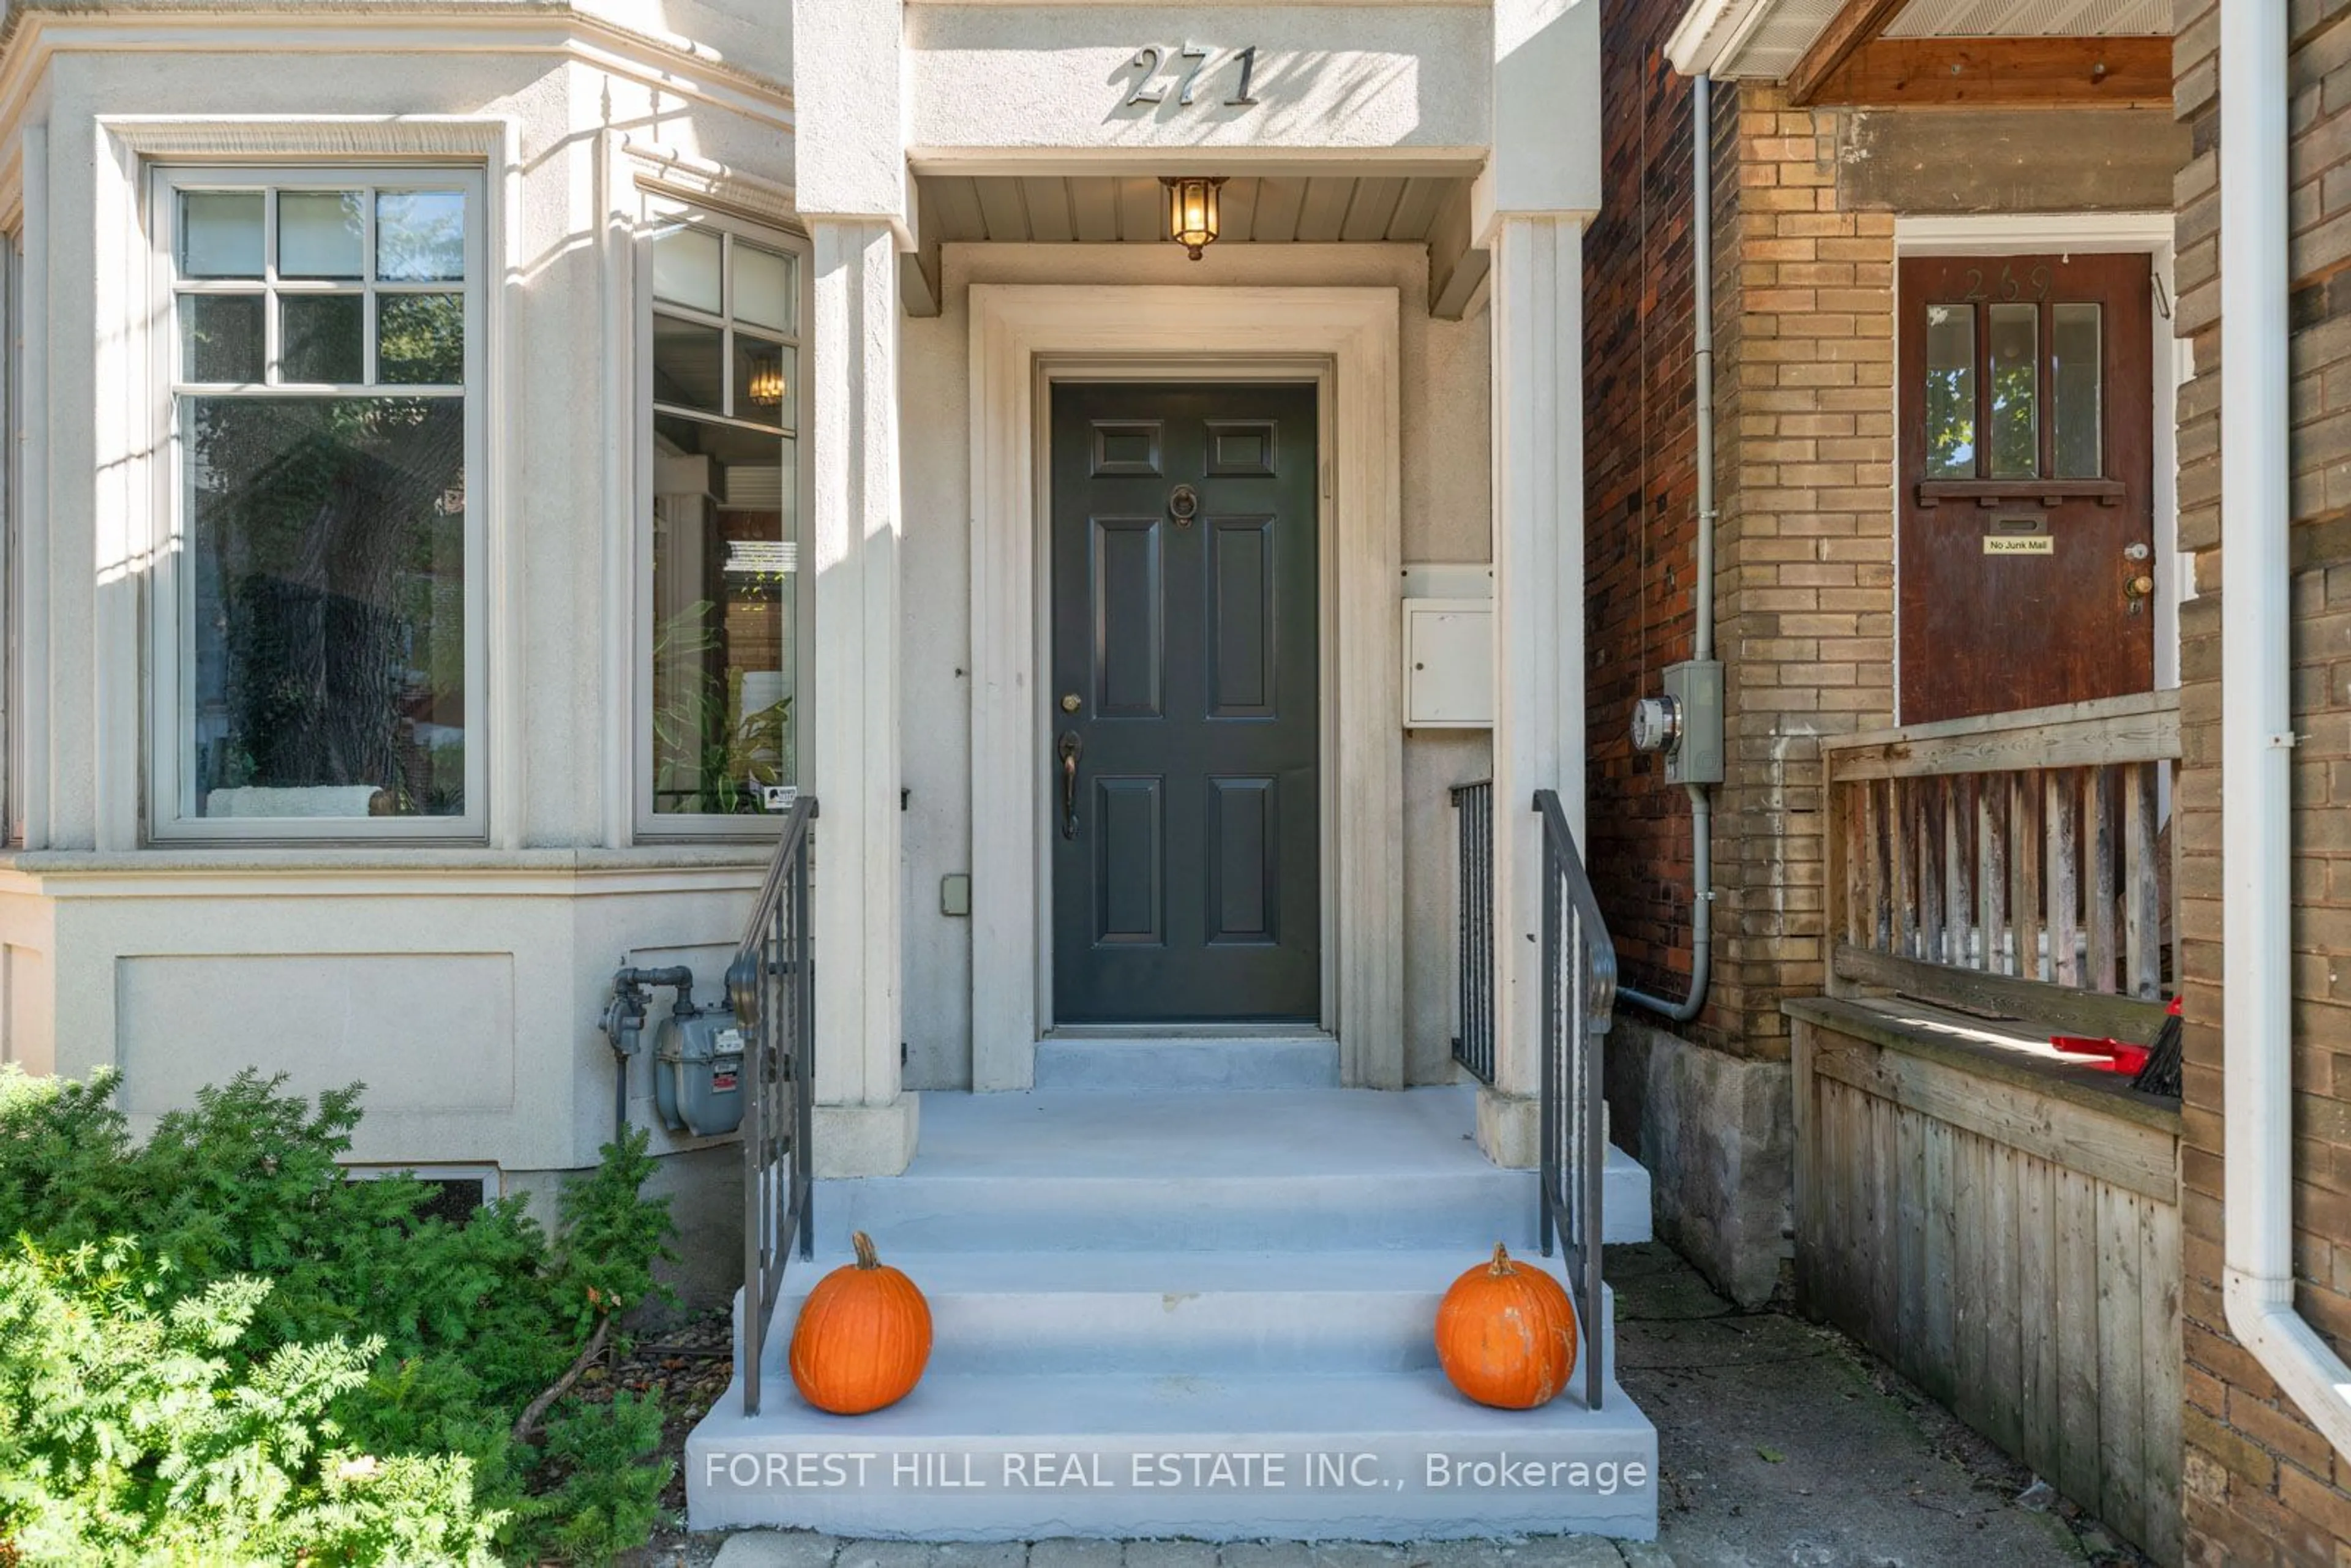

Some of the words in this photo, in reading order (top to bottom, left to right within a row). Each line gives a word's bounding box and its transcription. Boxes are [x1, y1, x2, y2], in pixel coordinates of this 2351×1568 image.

[1126, 39, 1259, 106] 271
[1965, 264, 2052, 302] 269
[1990, 541, 2004, 549] No
[2005, 541, 2027, 549] Junk
[2028, 541, 2047, 549] Mail
